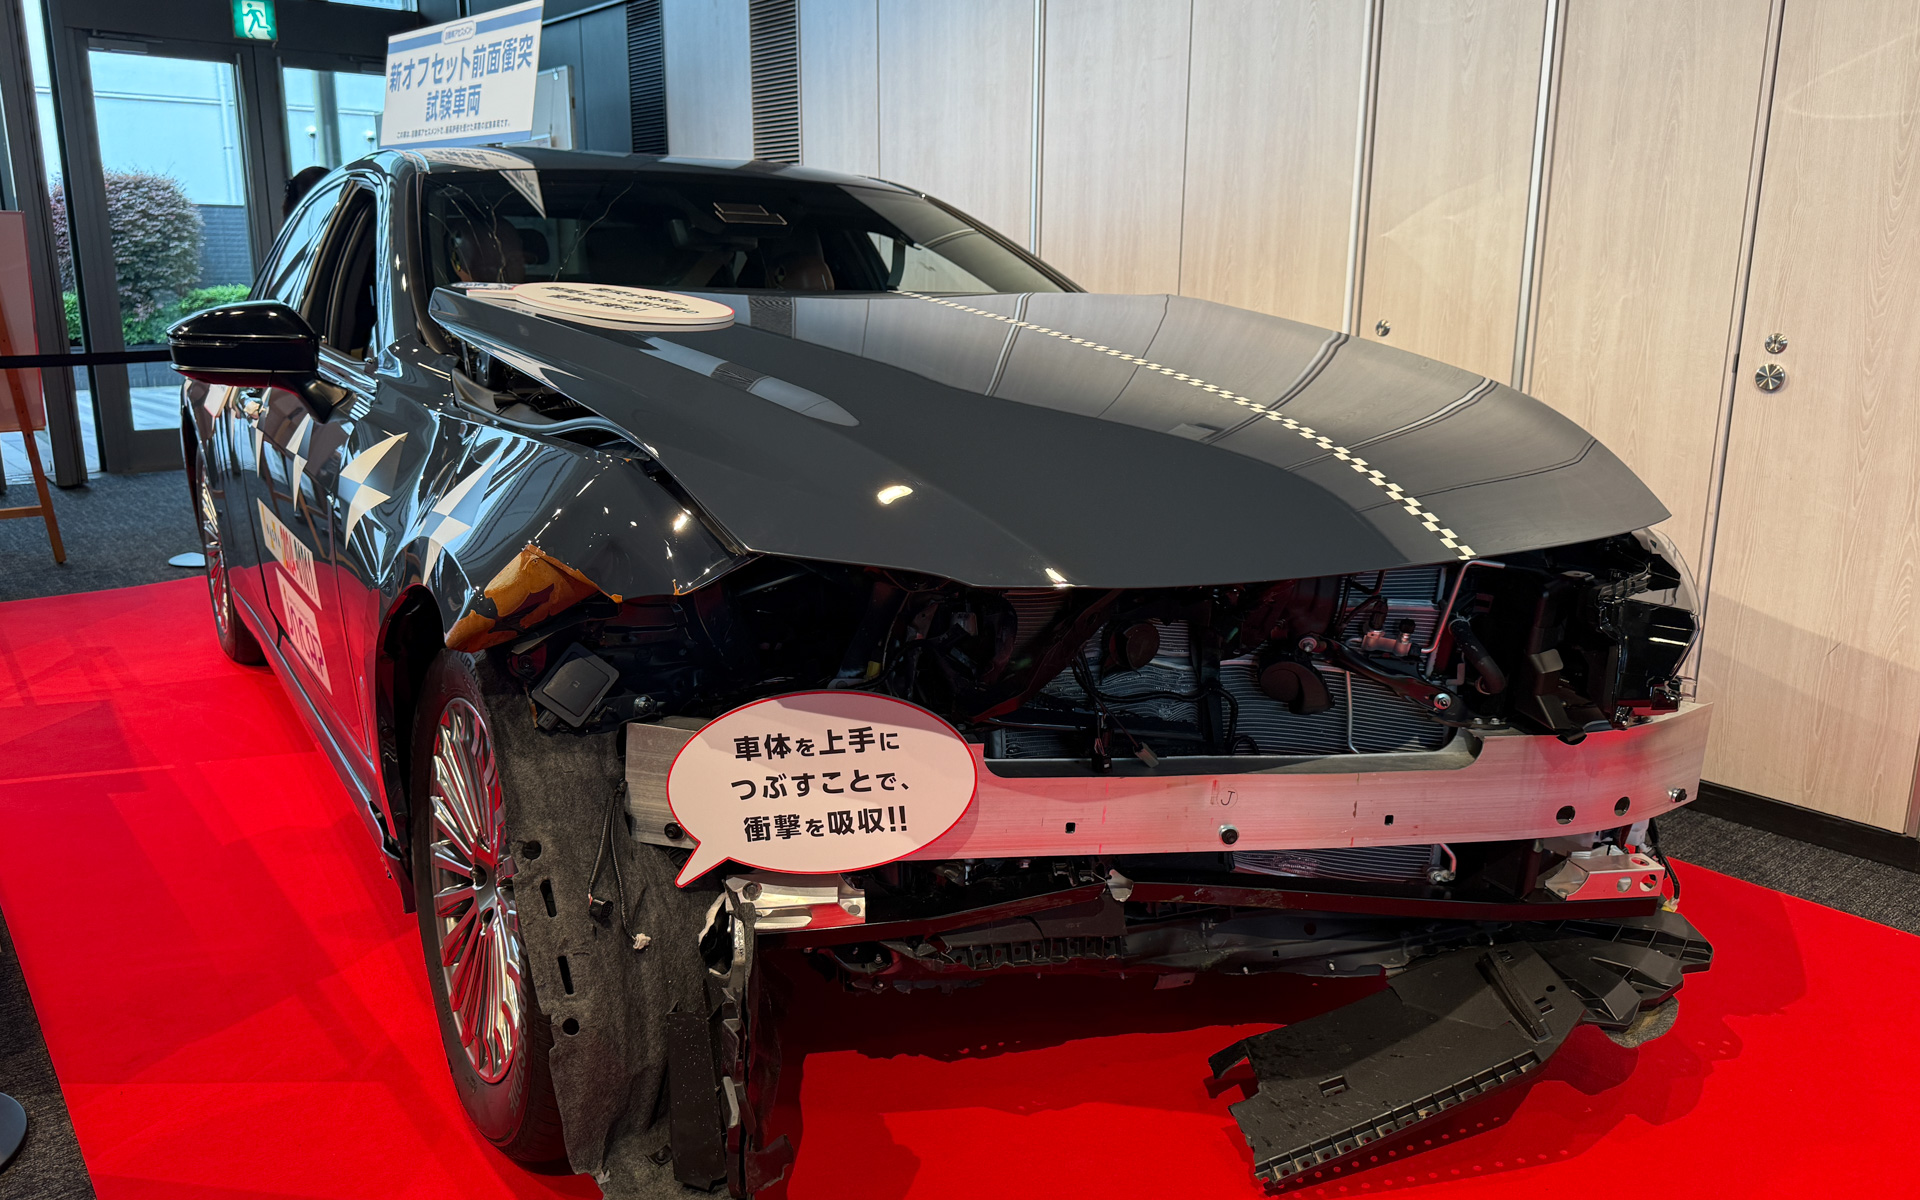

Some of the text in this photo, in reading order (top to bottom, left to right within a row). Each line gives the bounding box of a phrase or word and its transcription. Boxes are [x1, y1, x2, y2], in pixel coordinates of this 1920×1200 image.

[390, 34, 534, 93] 新オフセット前面衝突
[425, 84, 482, 122] 試験車両
[733, 726, 900, 761] 車体を上手に
[730, 769, 910, 801] つぶすことで、
[1220, 790, 1236, 806] J
